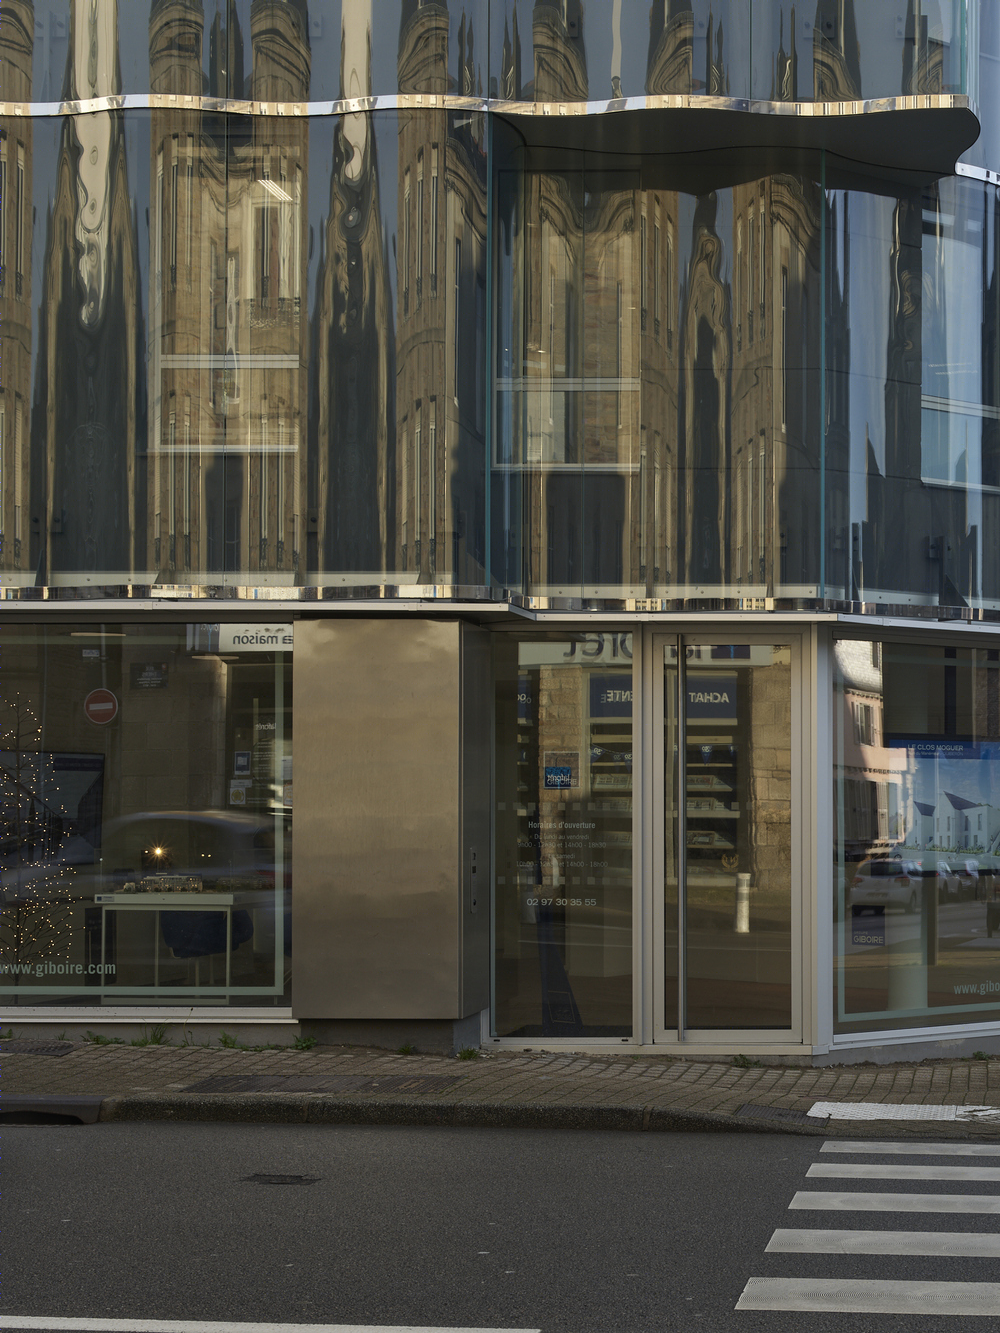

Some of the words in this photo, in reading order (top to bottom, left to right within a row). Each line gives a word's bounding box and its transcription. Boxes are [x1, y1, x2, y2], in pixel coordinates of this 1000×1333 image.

[559, 821, 596, 829] d'ouverture
[527, 898, 538, 906] 02
[541, 898, 553, 906] 97
[555, 898, 568, 906] 30
[570, 898, 582, 906] 35
[584, 898, 597, 906] 55
[853, 935, 884, 944] GIBOIRE
[0, 961, 116, 978] www.giboire.com
